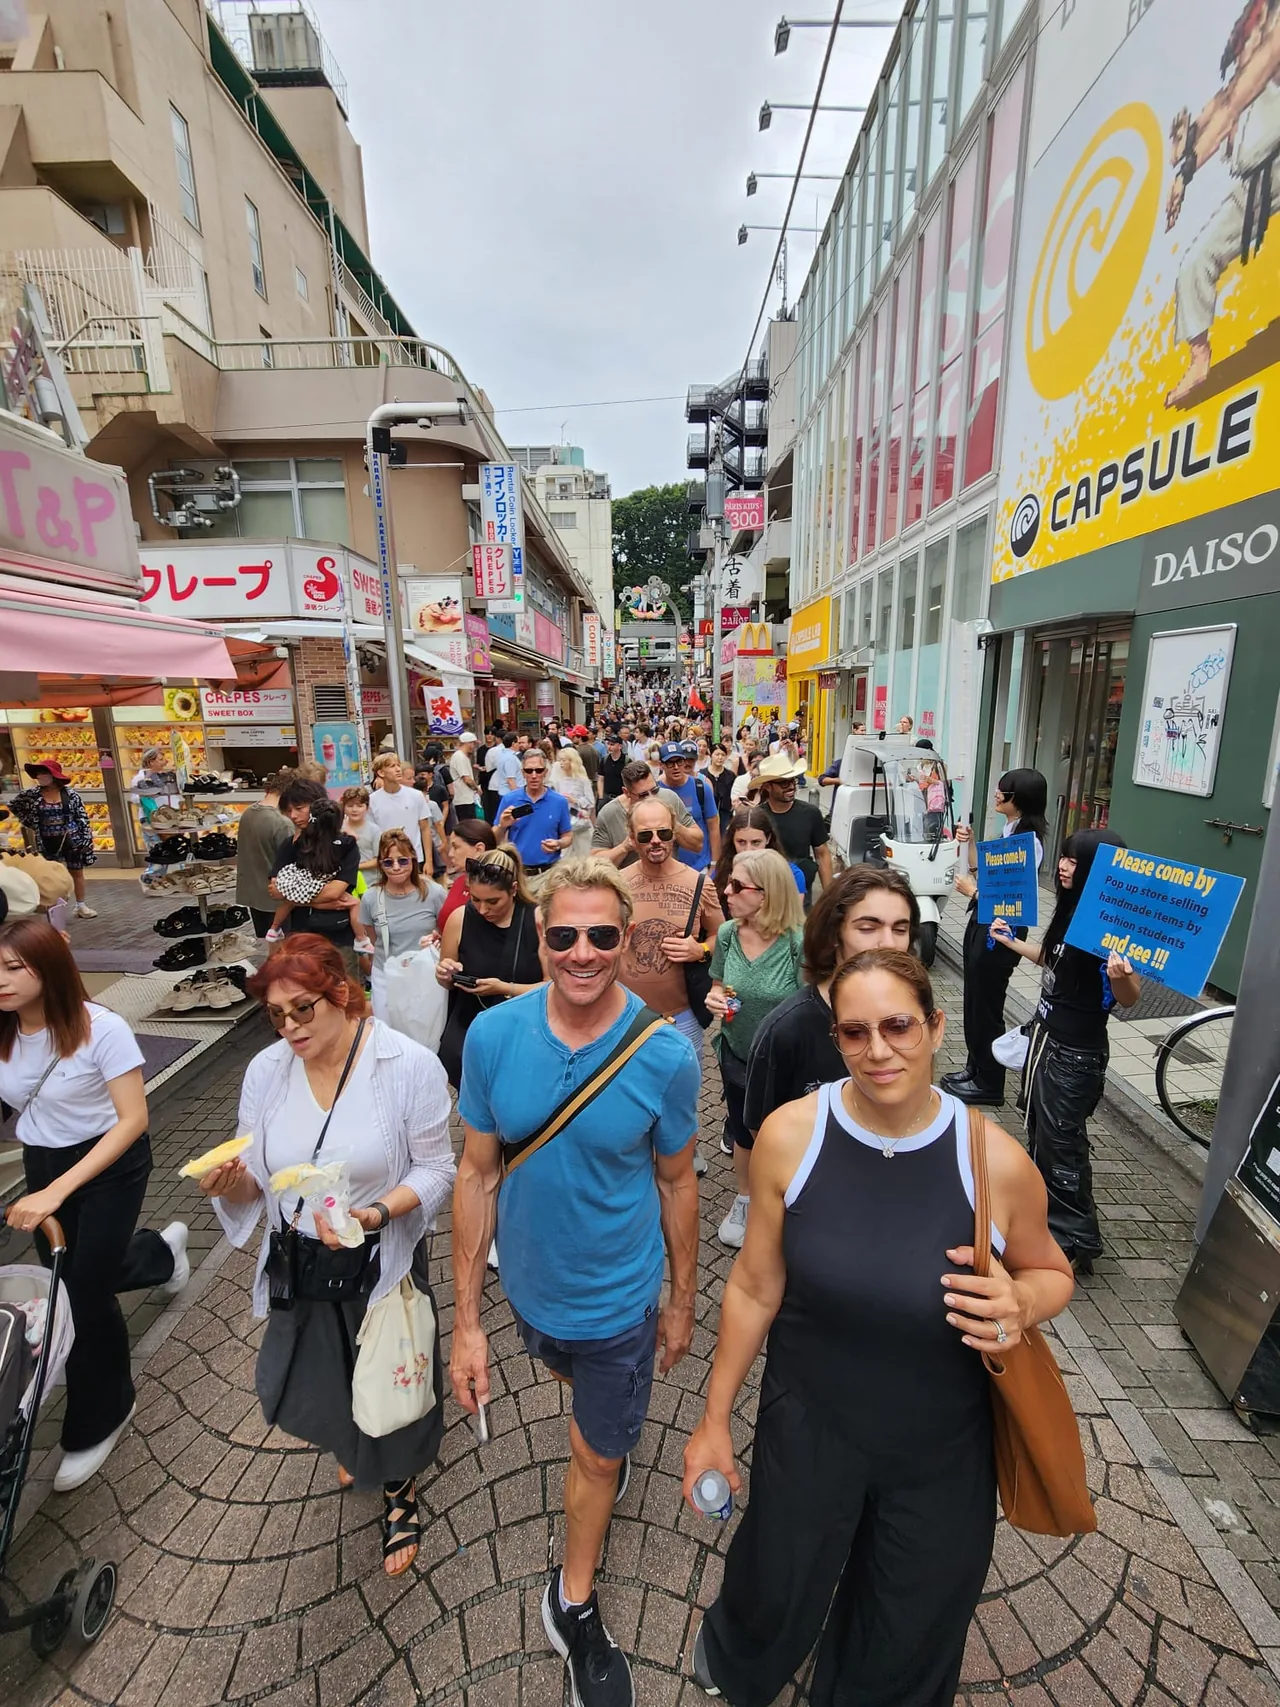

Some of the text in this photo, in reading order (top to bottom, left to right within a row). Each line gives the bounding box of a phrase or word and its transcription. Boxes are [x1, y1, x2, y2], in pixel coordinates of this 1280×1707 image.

[507, 467, 515, 493] Rental
[1051, 390, 1259, 532] CAPSULE
[0, 450, 115, 558] T&P
[372, 453, 383, 508] HARAJUKU
[378, 515, 388, 575] TAKESHITA
[494, 467, 507, 543] コインロッカー
[508, 495, 516, 515] Coin
[486, 547, 494, 594] CREPES
[494, 547, 506, 594] クレープ
[1152, 523, 1279, 587] DAISO
[353, 569, 382, 599] SWEE
[722, 558, 743, 599] 古着
[588, 625, 597, 664] COFFEE
[205, 691, 260, 703] CREPES
[985, 847, 1026, 867] Please come by
[1111, 847, 1217, 897] Please come by
[993, 900, 1005, 916] and
[1005, 903, 1015, 917] see
[1099, 892, 1202, 937] handmade items by
[1105, 875, 1209, 918] Pop up store selling
[1099, 909, 1186, 950] fashion students
[1101, 932, 1130, 954] and
[1127, 943, 1151, 964] see
[1150, 947, 1171, 971] !!!
